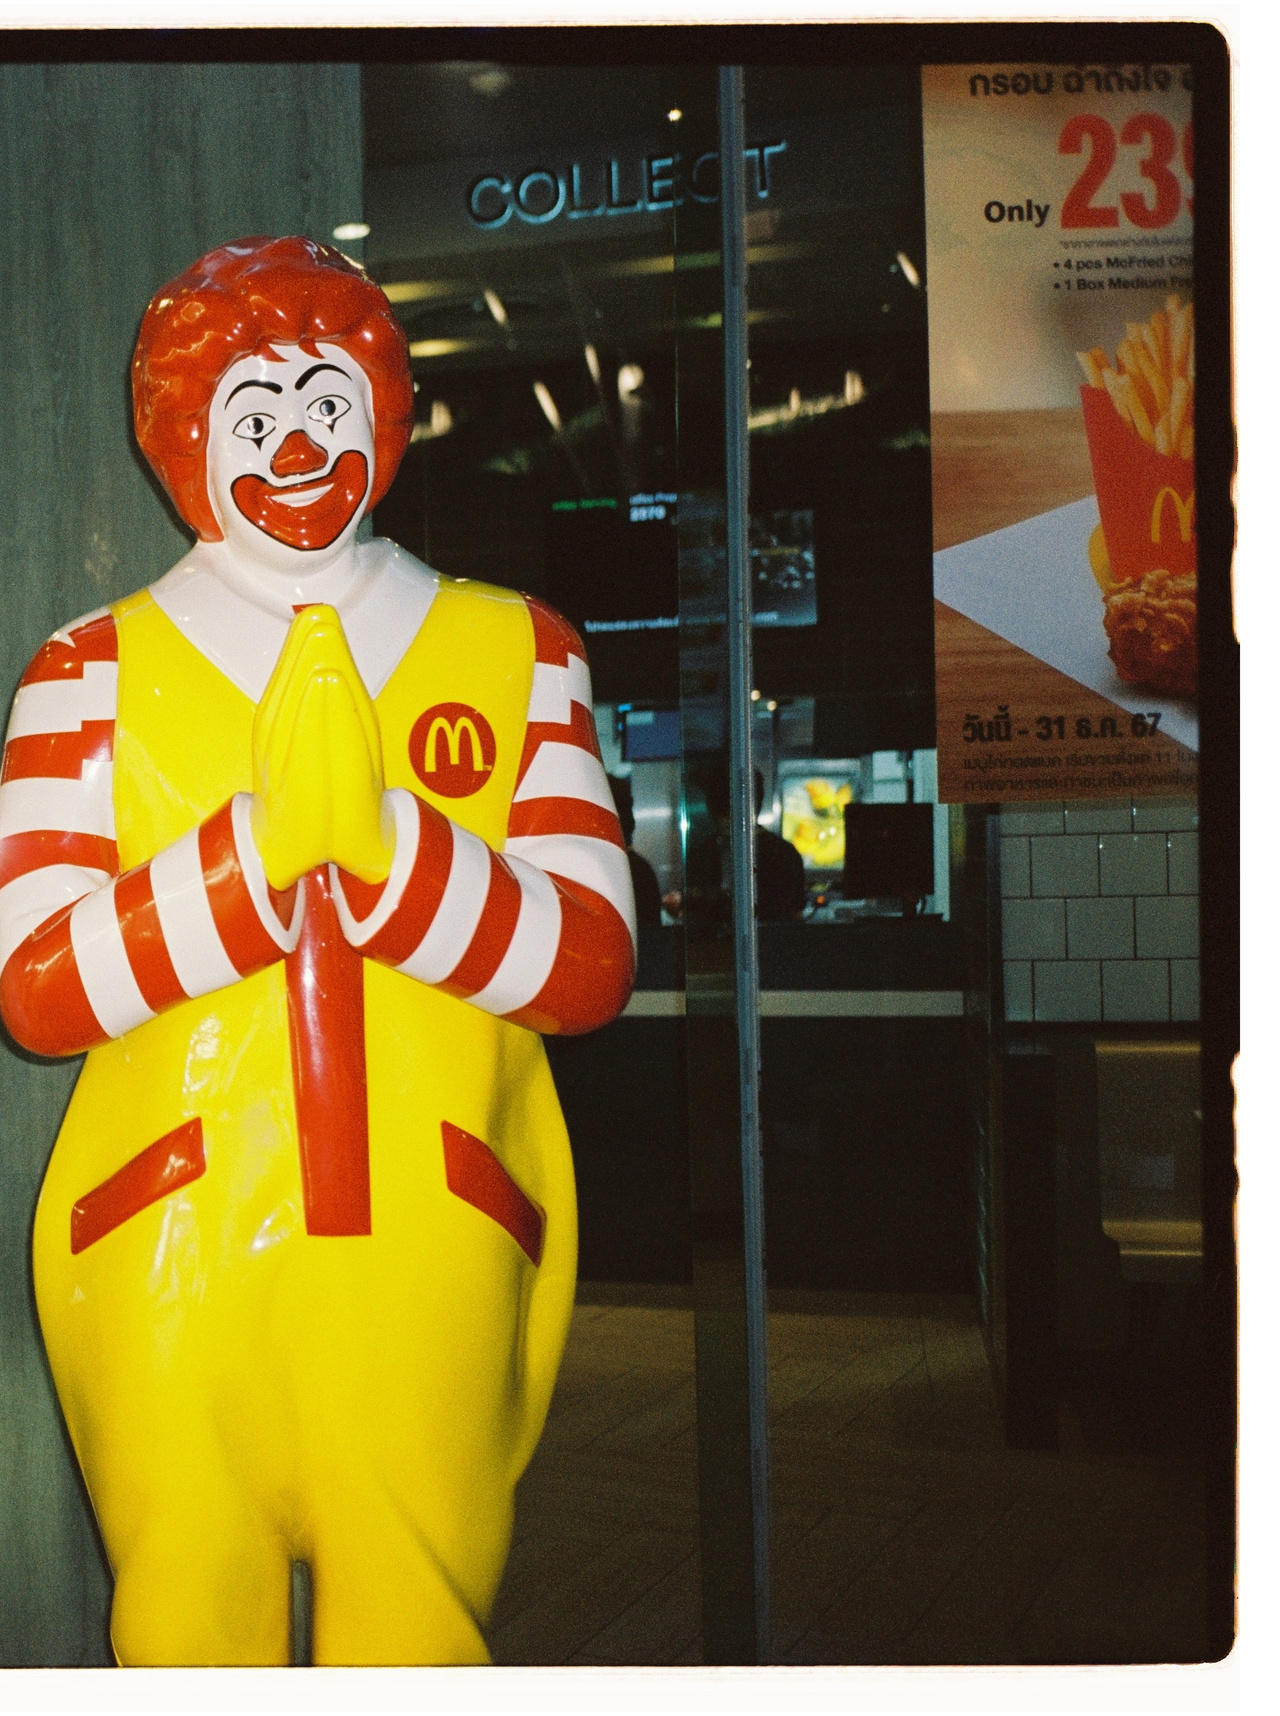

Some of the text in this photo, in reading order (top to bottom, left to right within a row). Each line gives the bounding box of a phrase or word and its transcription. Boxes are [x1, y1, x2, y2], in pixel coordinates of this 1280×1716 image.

[469, 140, 787, 229] COLLECT
[1058, 113, 1194, 229] 23
[984, 199, 1050, 228] Only
[1064, 259, 1072, 270] 4
[1076, 260, 1103, 272] pcs
[1106, 256, 1165, 269] McFried
[1077, 278, 1104, 290] Box
[1108, 277, 1166, 290] Medium
[962, 704, 1013, 743] วันนี้
[1036, 714, 1066, 741] 31
[1131, 712, 1163, 738] 67
